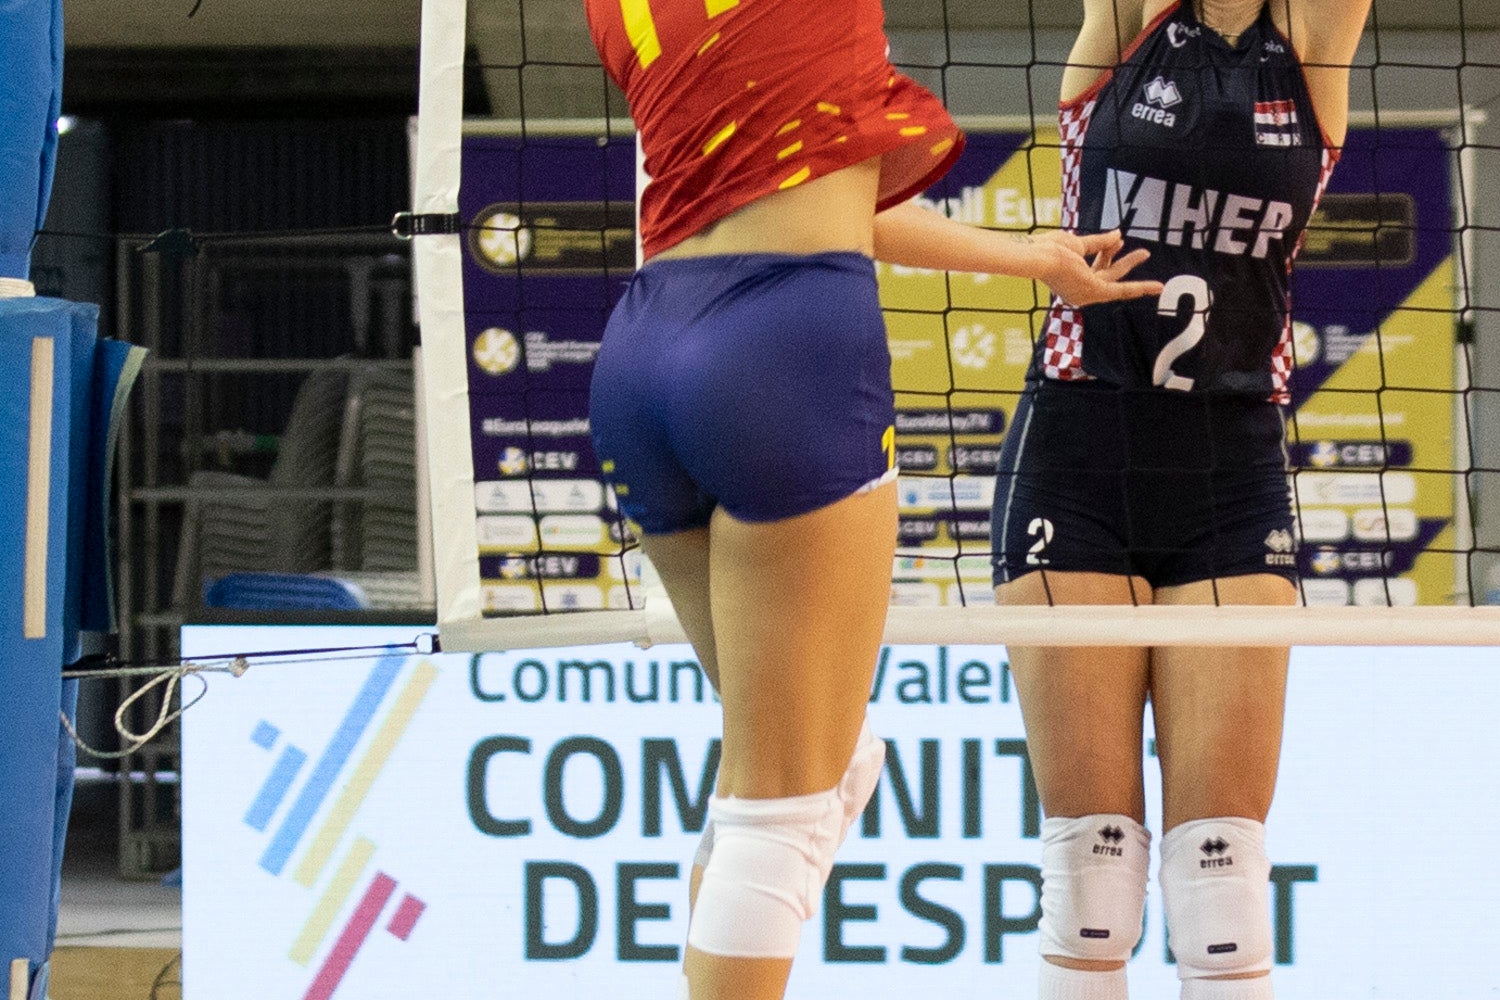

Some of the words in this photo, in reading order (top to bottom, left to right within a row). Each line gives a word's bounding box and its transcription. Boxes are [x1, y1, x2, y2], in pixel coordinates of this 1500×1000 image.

[1131, 102, 1176, 128] errea
[1152, 274, 1214, 392] 2
[528, 451, 578, 470] CEV
[1026, 517, 1054, 565] 2
[529, 556, 578, 575] CEV
[469, 651, 705, 703] Comun
[1092, 843, 1123, 857] errea
[1200, 856, 1233, 869] errea
[523, 860, 681, 963] DE
